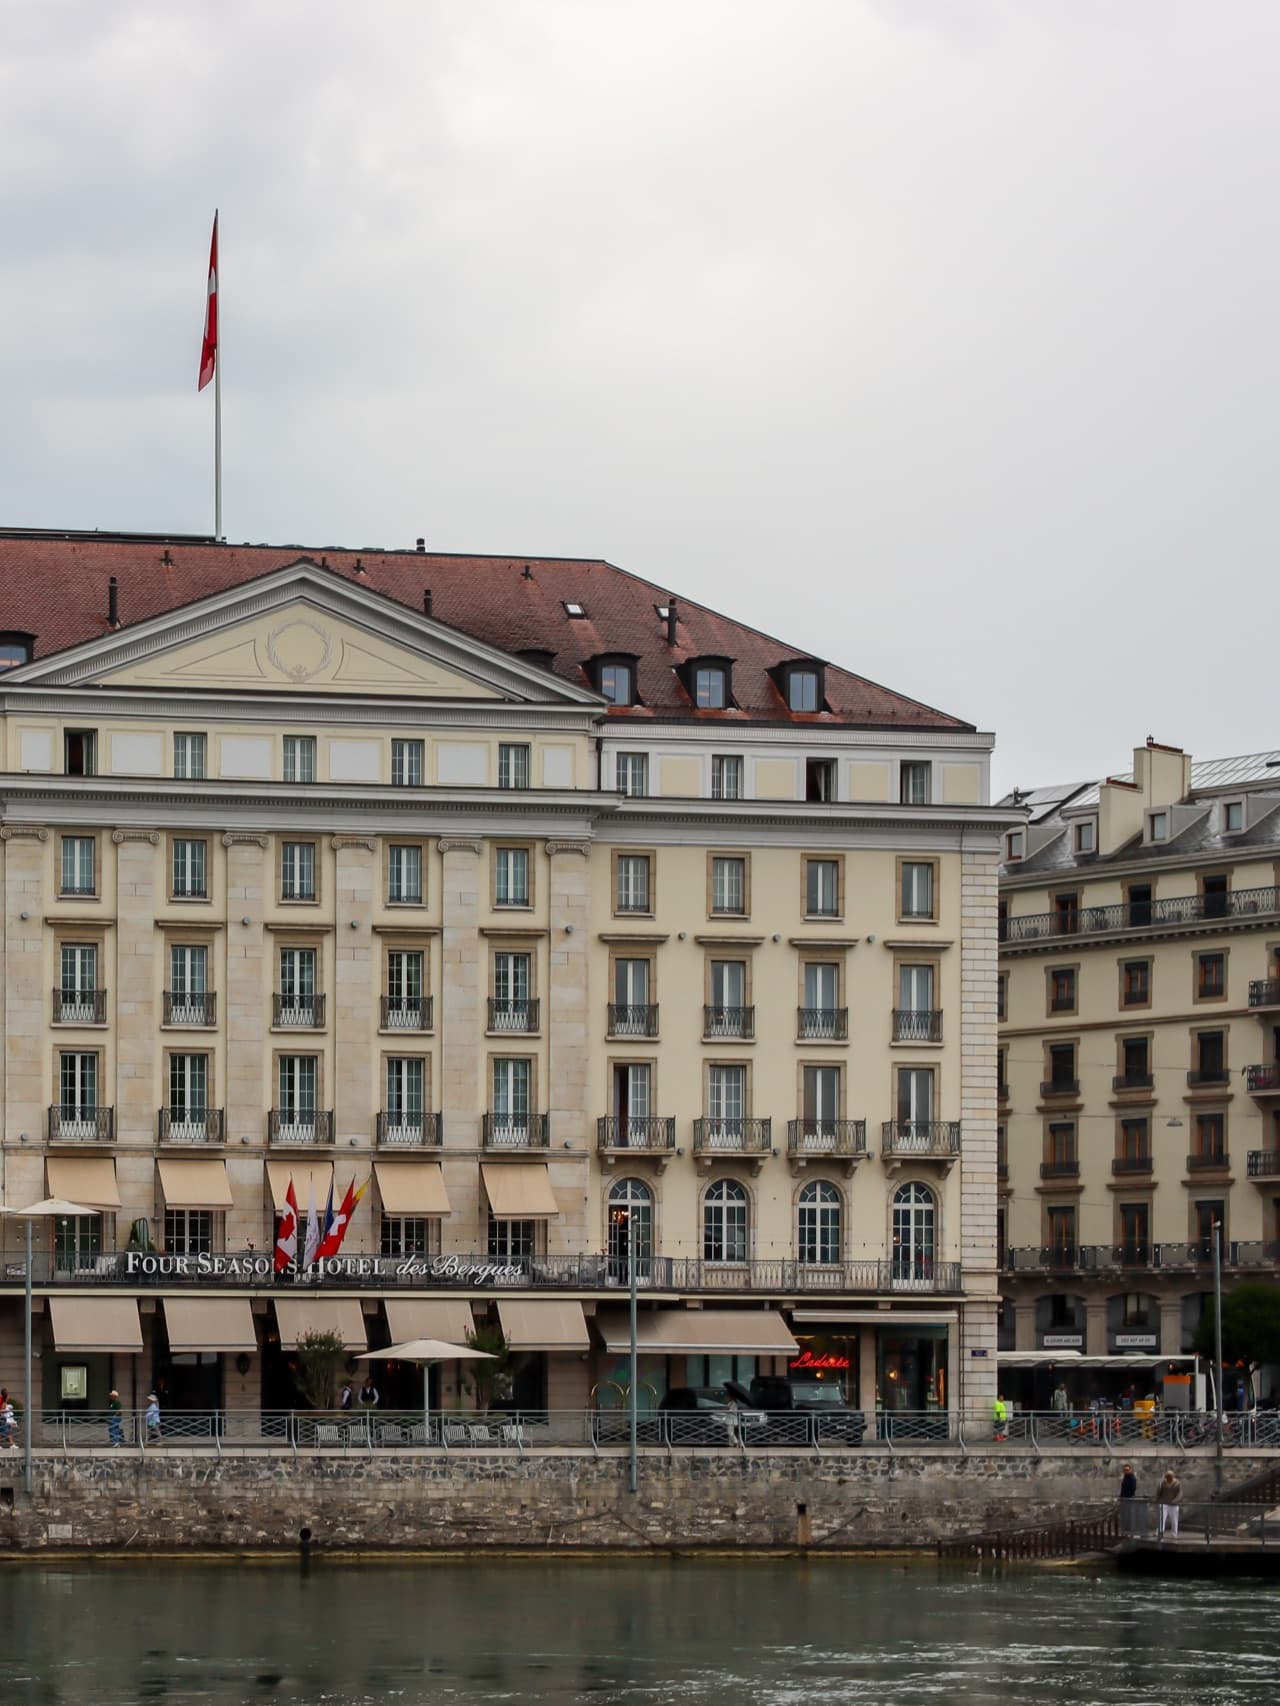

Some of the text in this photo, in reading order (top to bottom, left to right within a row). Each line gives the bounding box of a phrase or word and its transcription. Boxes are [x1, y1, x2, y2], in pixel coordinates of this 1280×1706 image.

[125, 1251, 190, 1274] FOUR
[197, 1251, 297, 1275] SEASOS
[395, 1254, 432, 1276] des
[431, 1254, 523, 1285] Bergues
